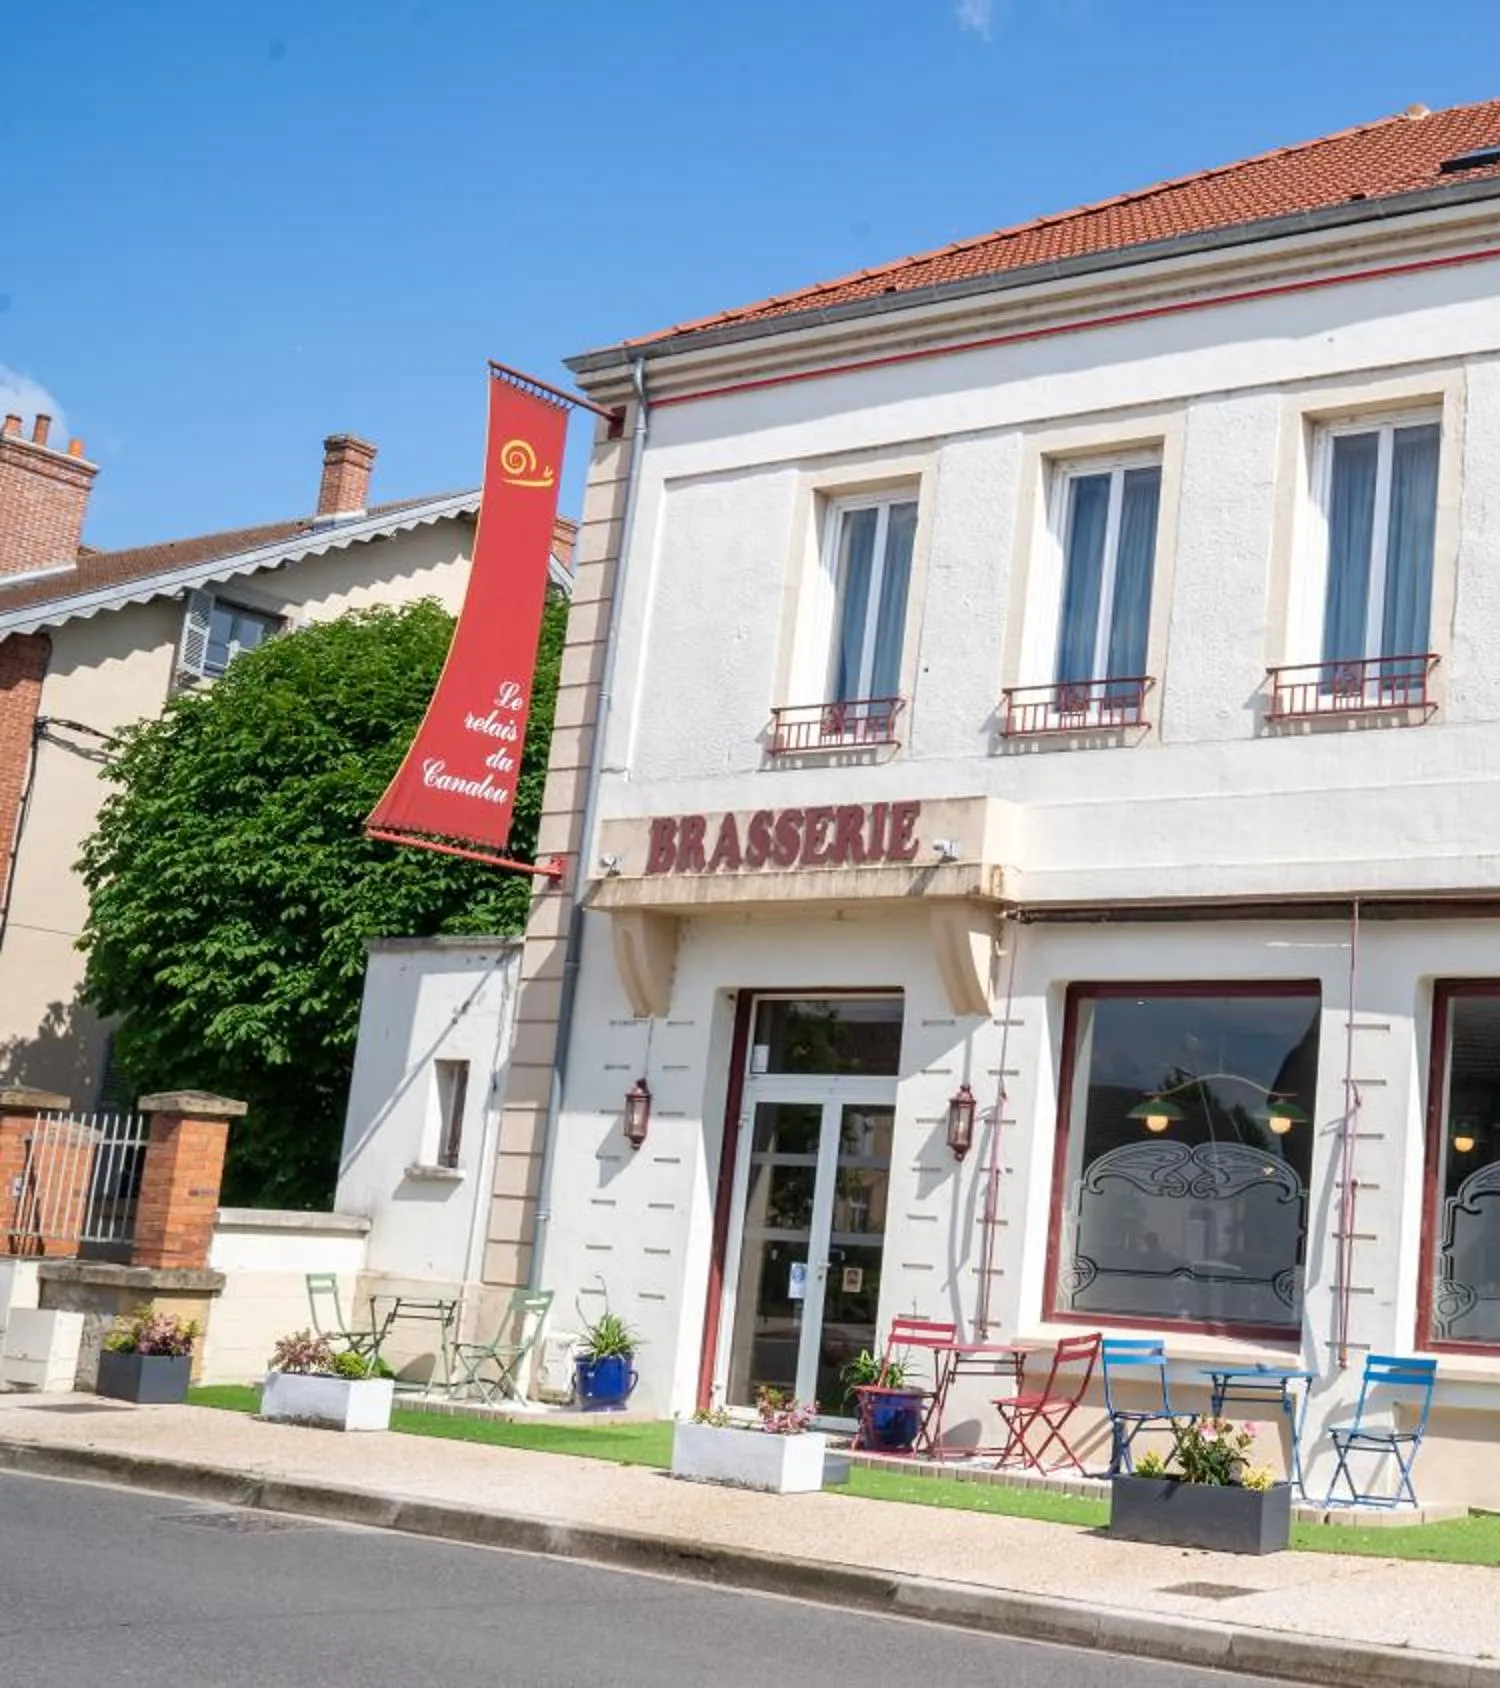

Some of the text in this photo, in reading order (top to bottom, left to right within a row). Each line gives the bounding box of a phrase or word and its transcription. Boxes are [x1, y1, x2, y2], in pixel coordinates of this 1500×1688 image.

[494, 681, 523, 711] Le
[464, 709, 518, 741] relais
[485, 747, 514, 772] du
[645, 799, 921, 877] BRASSERIE
